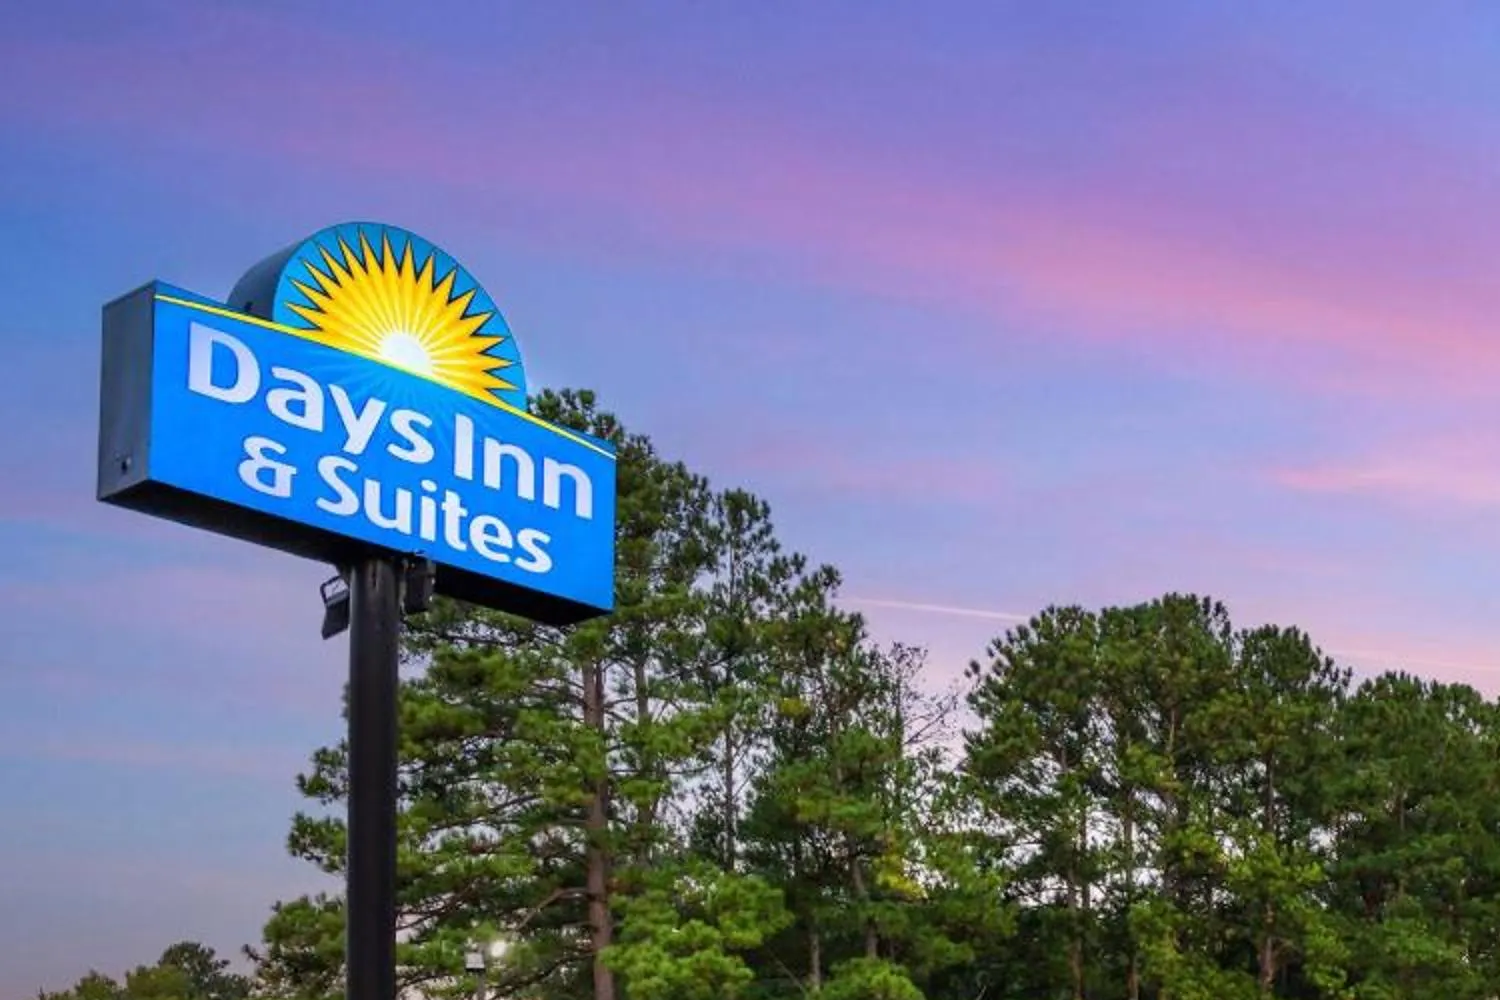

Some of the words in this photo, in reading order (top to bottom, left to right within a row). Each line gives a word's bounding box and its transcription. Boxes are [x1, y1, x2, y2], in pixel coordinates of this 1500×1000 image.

[188, 320, 434, 464] Days
[453, 413, 593, 519] Inn
[237, 436, 297, 498] &
[316, 456, 553, 574] Suites
